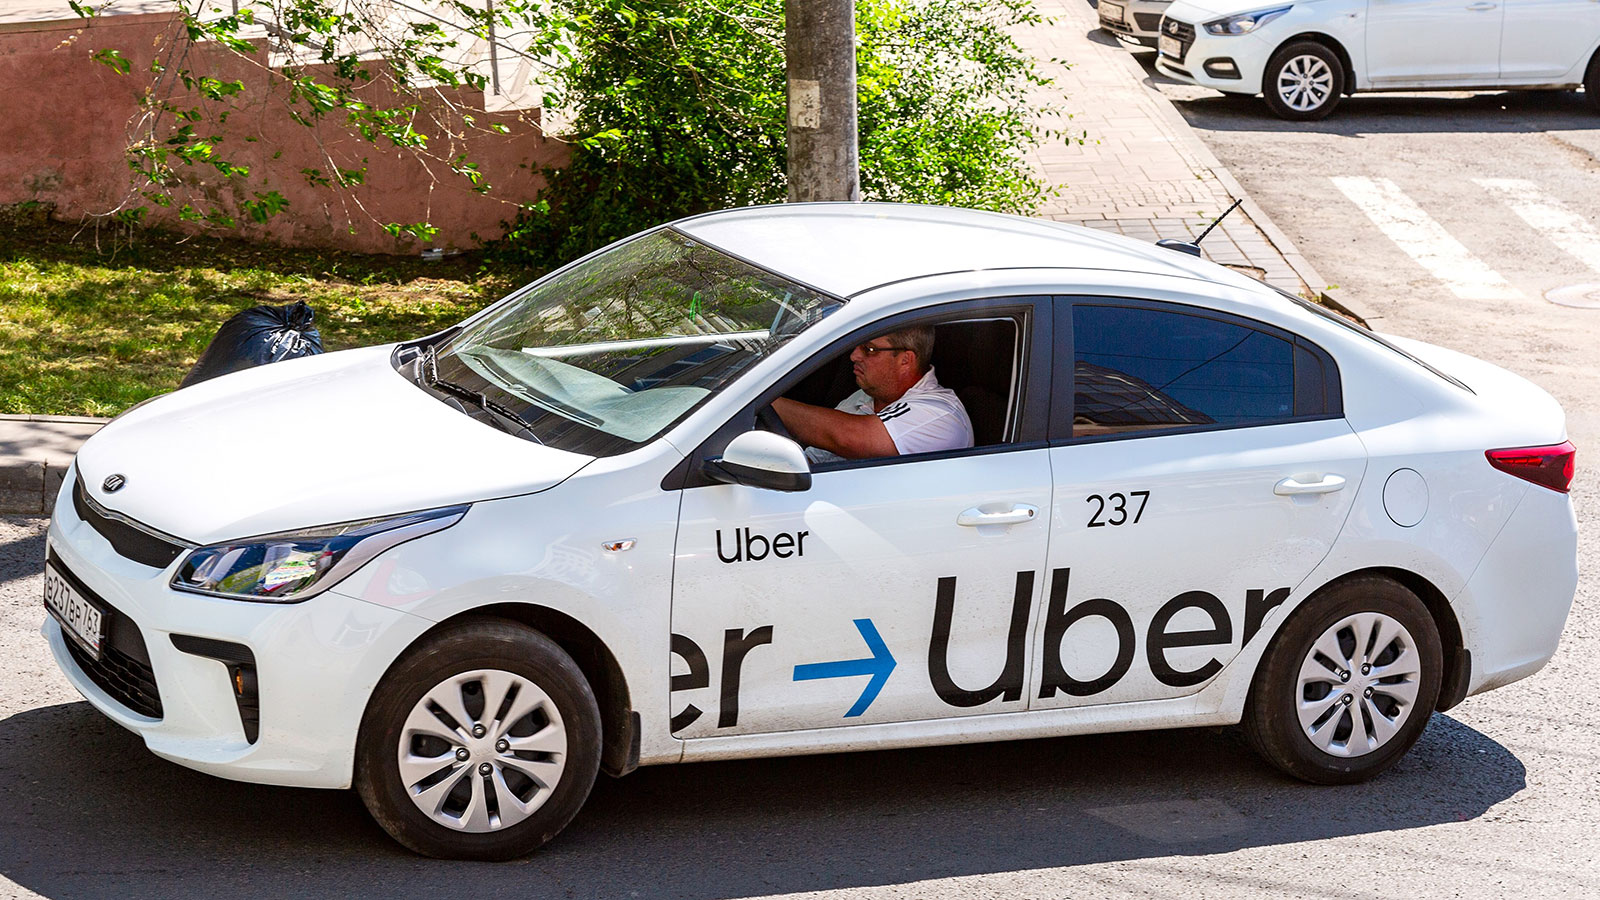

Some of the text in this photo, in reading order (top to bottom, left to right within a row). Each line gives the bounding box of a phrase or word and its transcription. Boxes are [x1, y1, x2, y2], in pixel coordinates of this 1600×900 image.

[1086, 491, 1150, 528] 237
[716, 527, 809, 563] Uber
[83, 602, 99, 634] 763
[928, 568, 1291, 707] Uber
